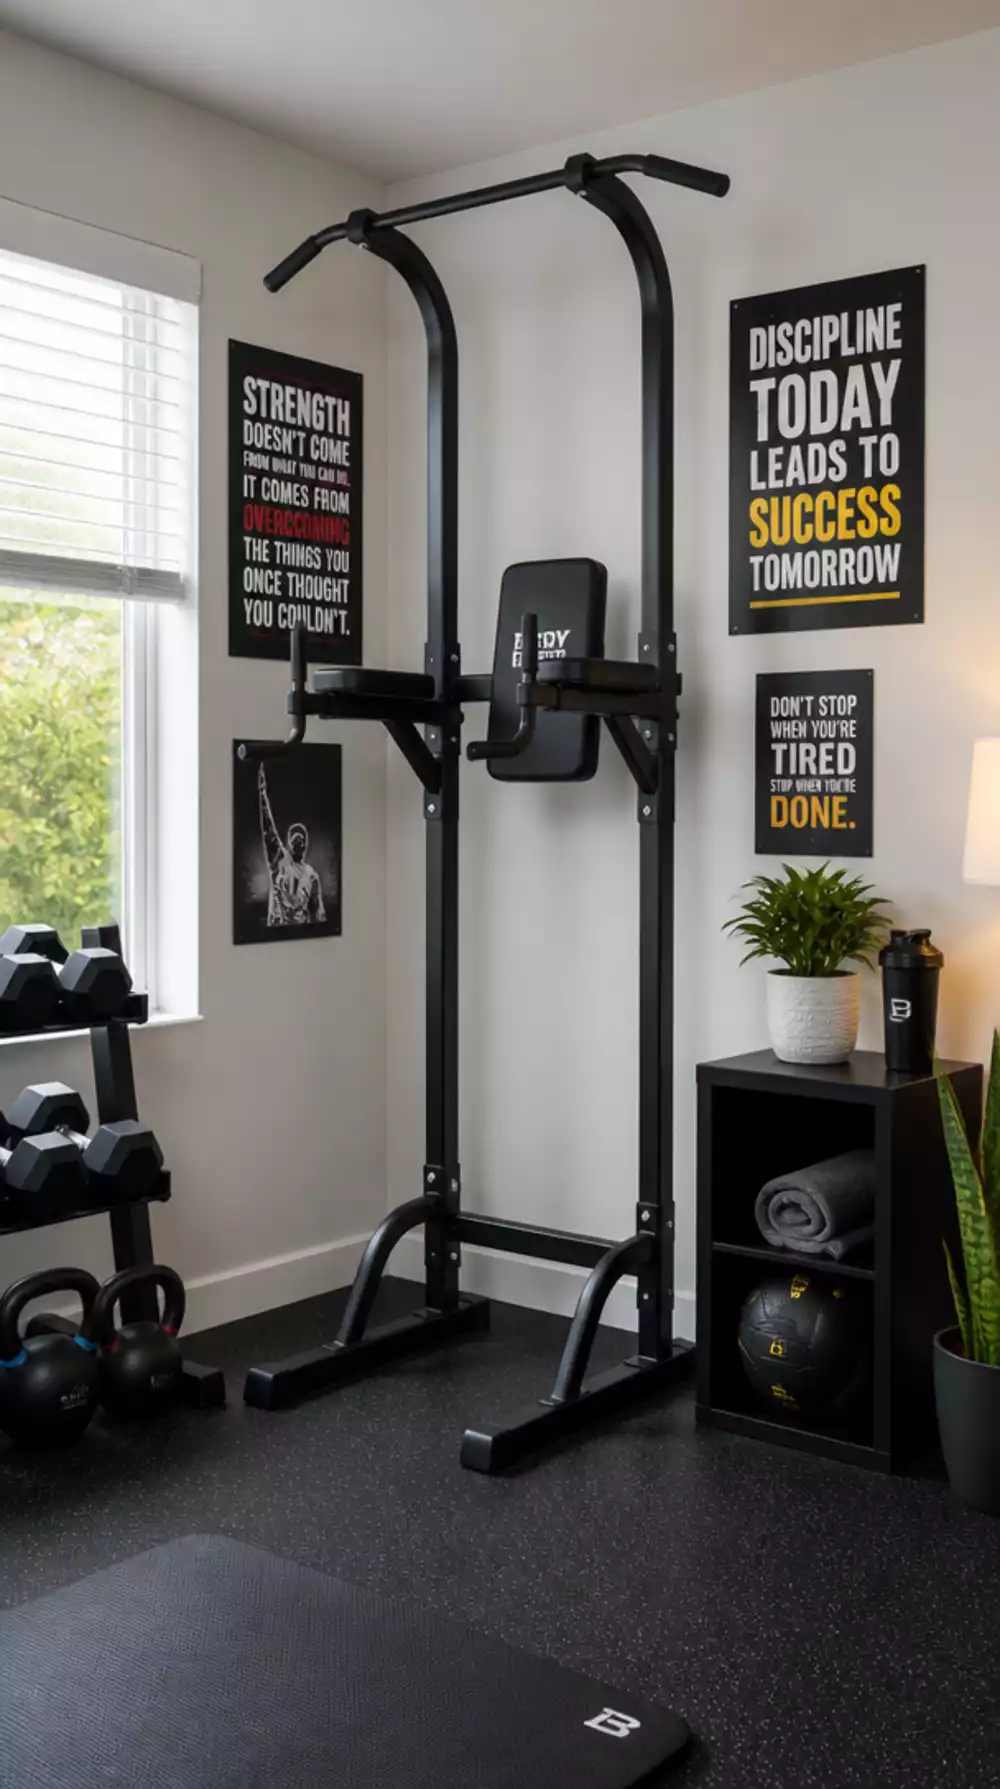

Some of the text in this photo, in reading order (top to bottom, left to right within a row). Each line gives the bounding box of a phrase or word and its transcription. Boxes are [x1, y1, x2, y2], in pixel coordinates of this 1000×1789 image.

[750, 303, 902, 371] DISCIPLINE
[243, 376, 350, 436] STRENGTH
[750, 358, 902, 442] TODAY
[243, 419, 350, 467] DOESN'T COME
[751, 433, 900, 491] LEADS TO
[243, 474, 350, 514] IT COMES FROM
[243, 503, 350, 546] OVERCOMING
[750, 484, 902, 549] SUCCESS
[243, 536, 350, 573] THE THINGS YOU
[750, 543, 901, 592] TOMORROW
[243, 567, 350, 603] ONCE THOUGHT
[243, 598, 273, 627] YOU
[514, 629, 571, 650] BDY
[770, 695, 857, 717] DON'T STOP
[770, 720, 857, 739] WHEN YOU'RE
[771, 742, 856, 775] TIRED
[770, 778, 794, 792] STOP
[770, 795, 856, 829] DONE.
